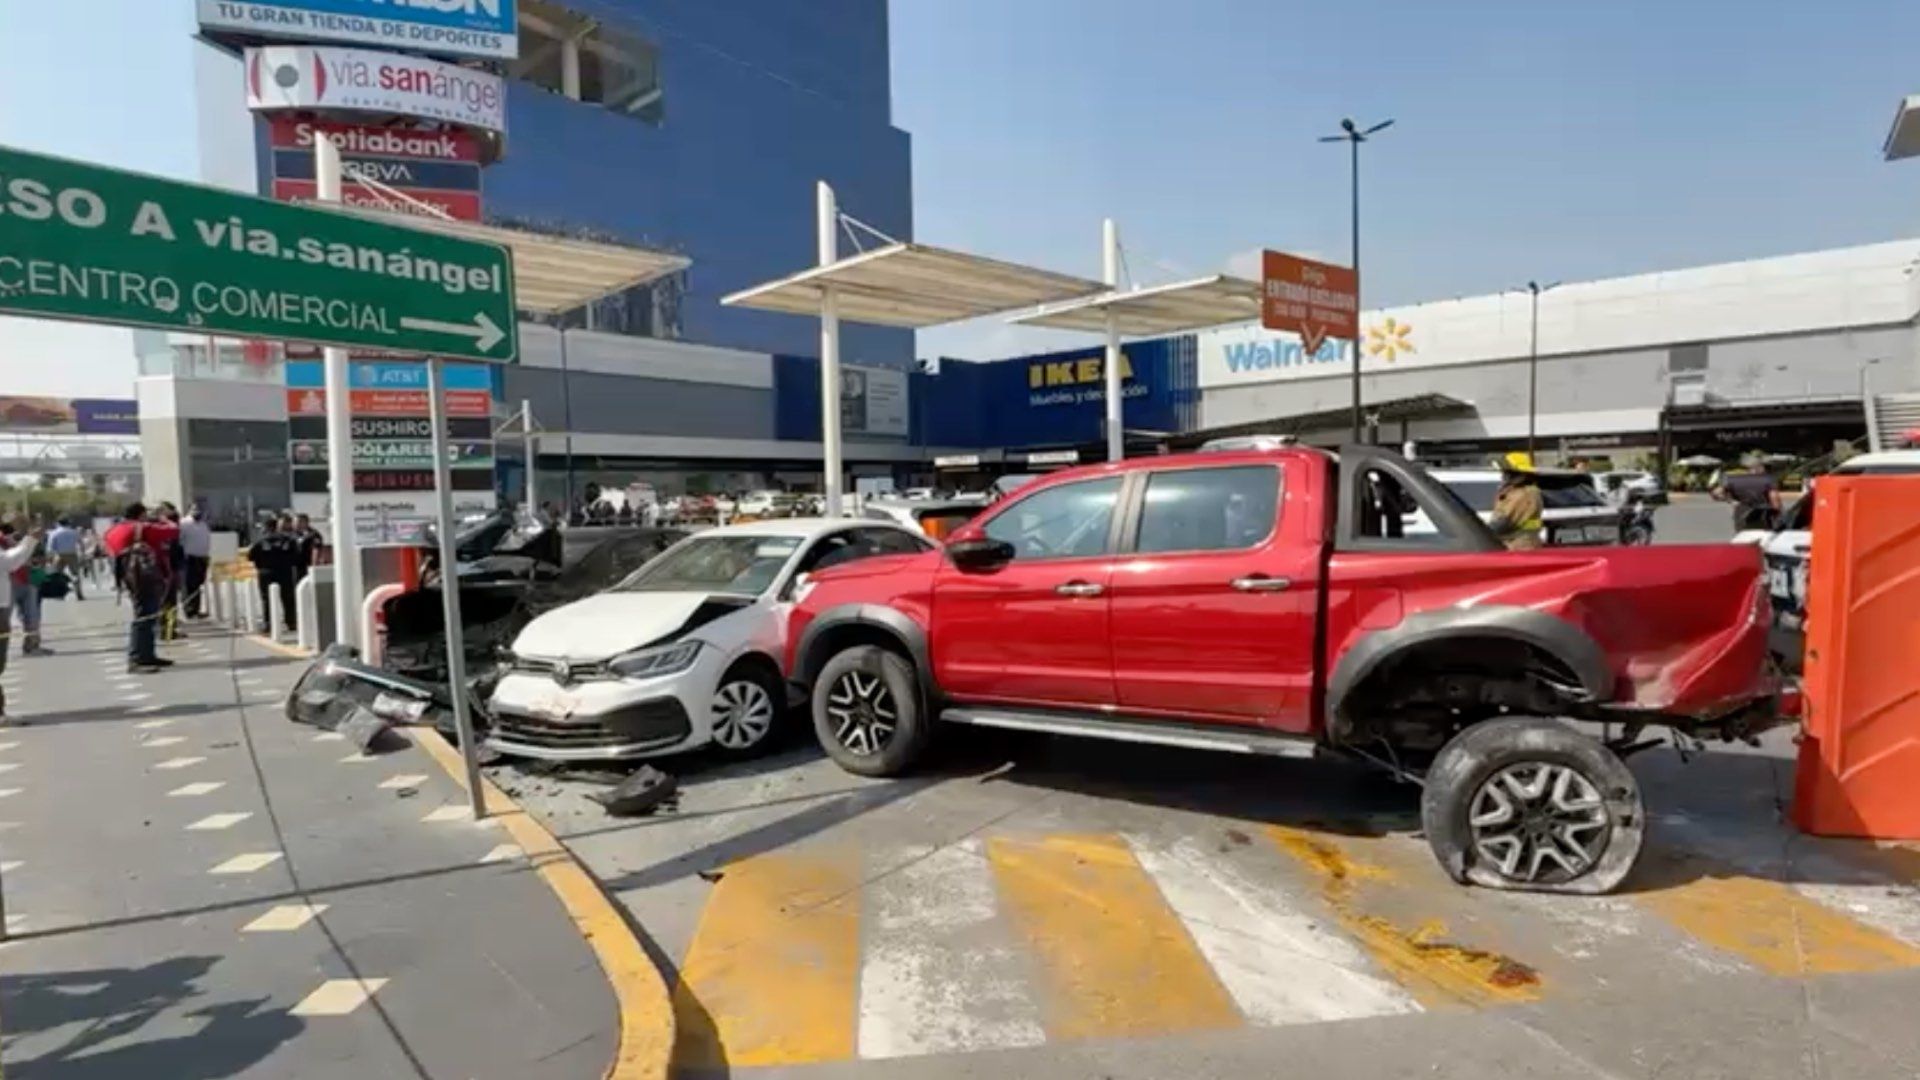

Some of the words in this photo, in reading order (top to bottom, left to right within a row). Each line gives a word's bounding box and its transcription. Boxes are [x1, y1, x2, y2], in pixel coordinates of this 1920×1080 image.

[219, 3, 244, 19] TU
[250, 7, 304, 26] GRAN
[310, 14, 377, 34] TIENDA
[382, 21, 405, 39] DE
[410, 26, 502, 49] DEPORTES
[296, 123, 458, 157] Sotiabank
[0, 178, 107, 228] SO
[130, 201, 177, 241] A
[194, 215, 502, 293] via.sanángel
[0, 256, 180, 311] CENTRO
[192, 282, 398, 334] COMERCIAL
